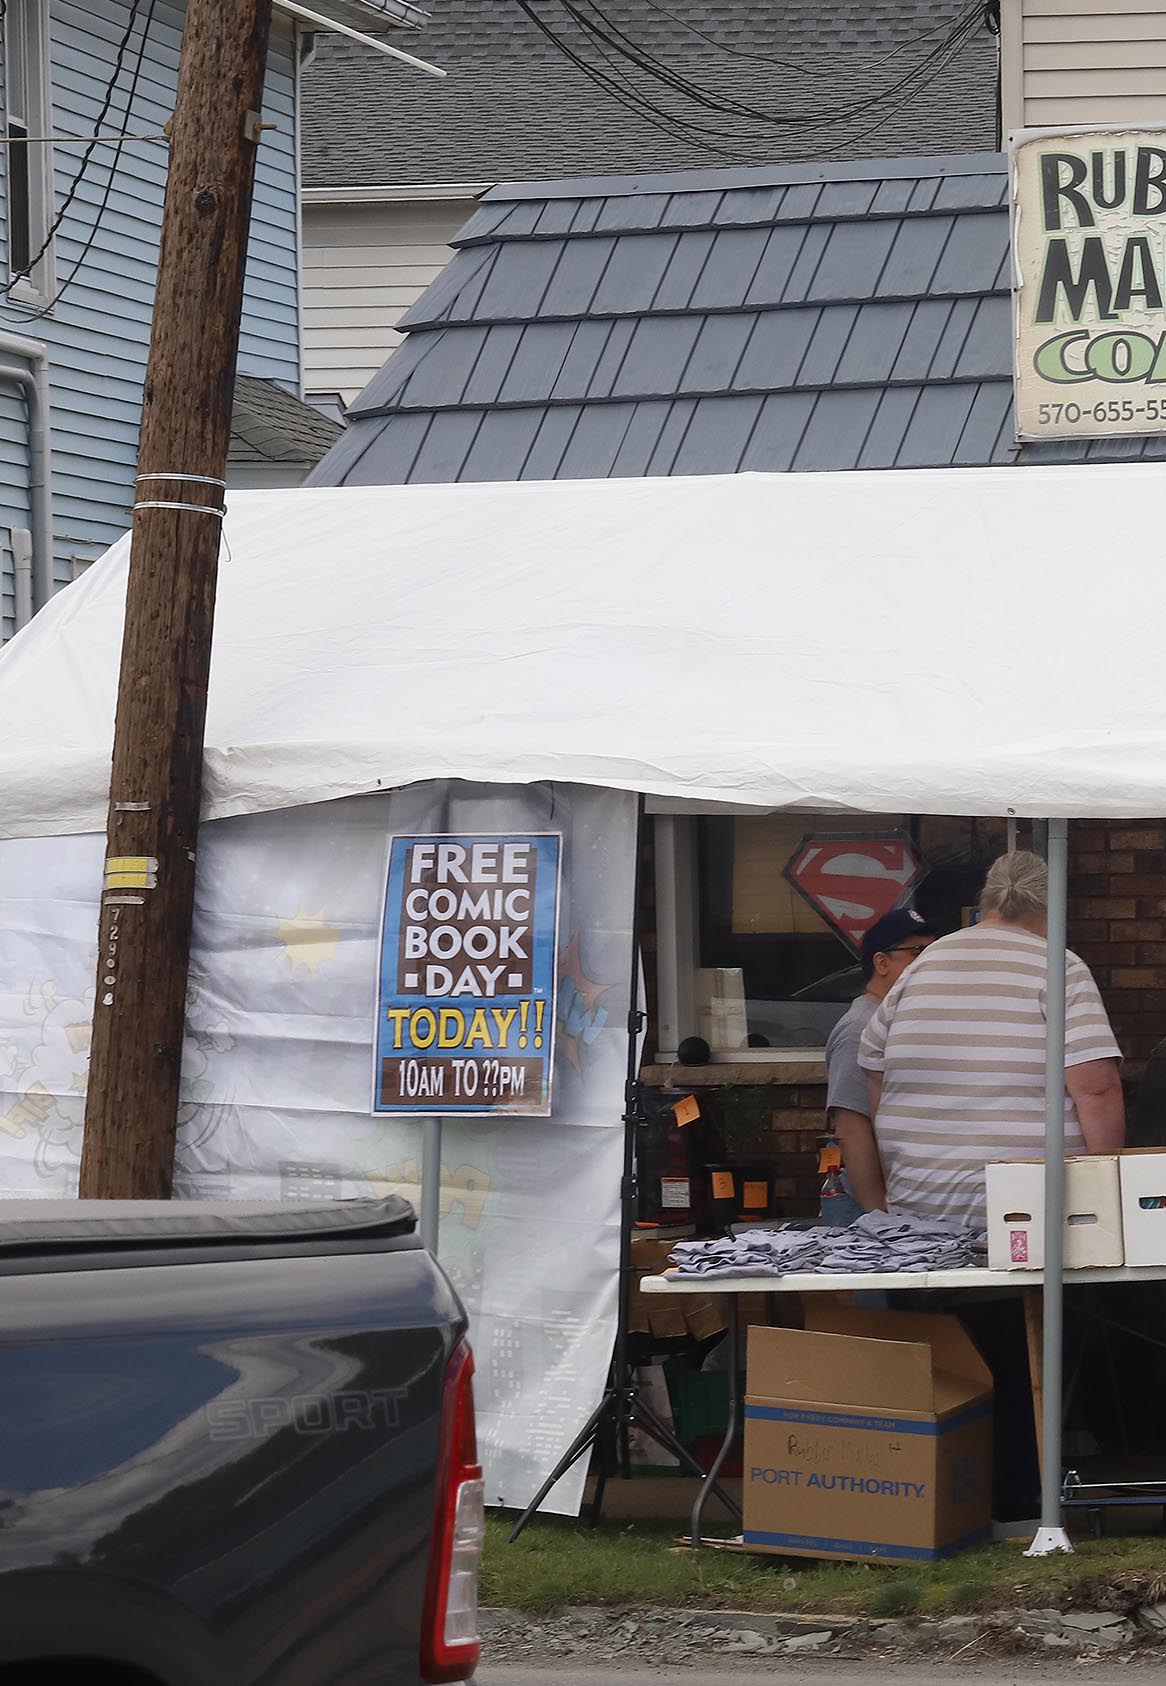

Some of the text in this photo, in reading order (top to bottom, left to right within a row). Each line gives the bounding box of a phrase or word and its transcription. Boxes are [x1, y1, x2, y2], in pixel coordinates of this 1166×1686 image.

[410, 843, 530, 884] FREE
[405, 888, 530, 921] COMIC
[404, 925, 528, 960] BOOK
[425, 964, 507, 997] DAY
[386, 1000, 545, 1050] TODAY!!
[399, 1059, 525, 1097] 10AM TO ??PM
[206, 1387, 409, 1441] SPORT
[750, 1467, 925, 1498] PORT AUTHORITY
